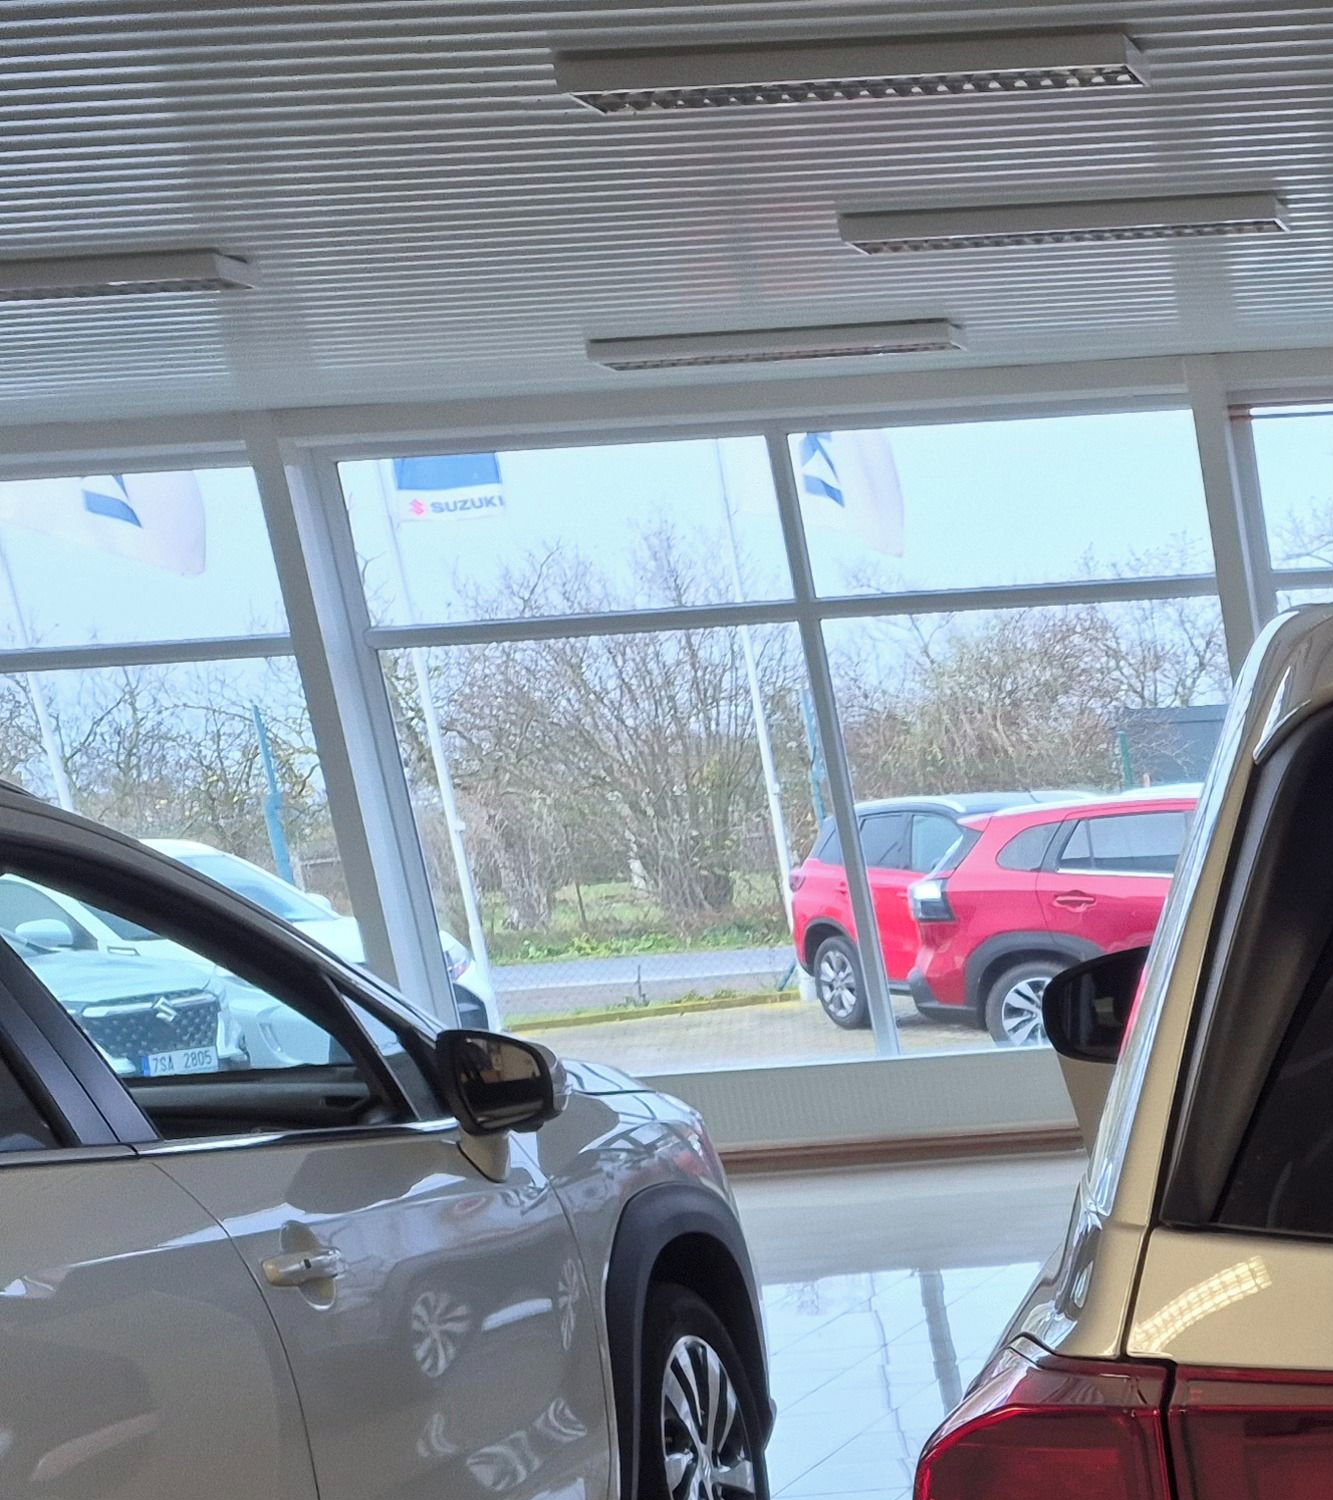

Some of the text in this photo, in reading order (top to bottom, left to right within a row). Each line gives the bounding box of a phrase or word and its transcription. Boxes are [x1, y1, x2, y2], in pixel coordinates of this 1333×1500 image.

[430, 495, 504, 514] SUZUKI
[151, 1049, 213, 1073] 7SA 2805
